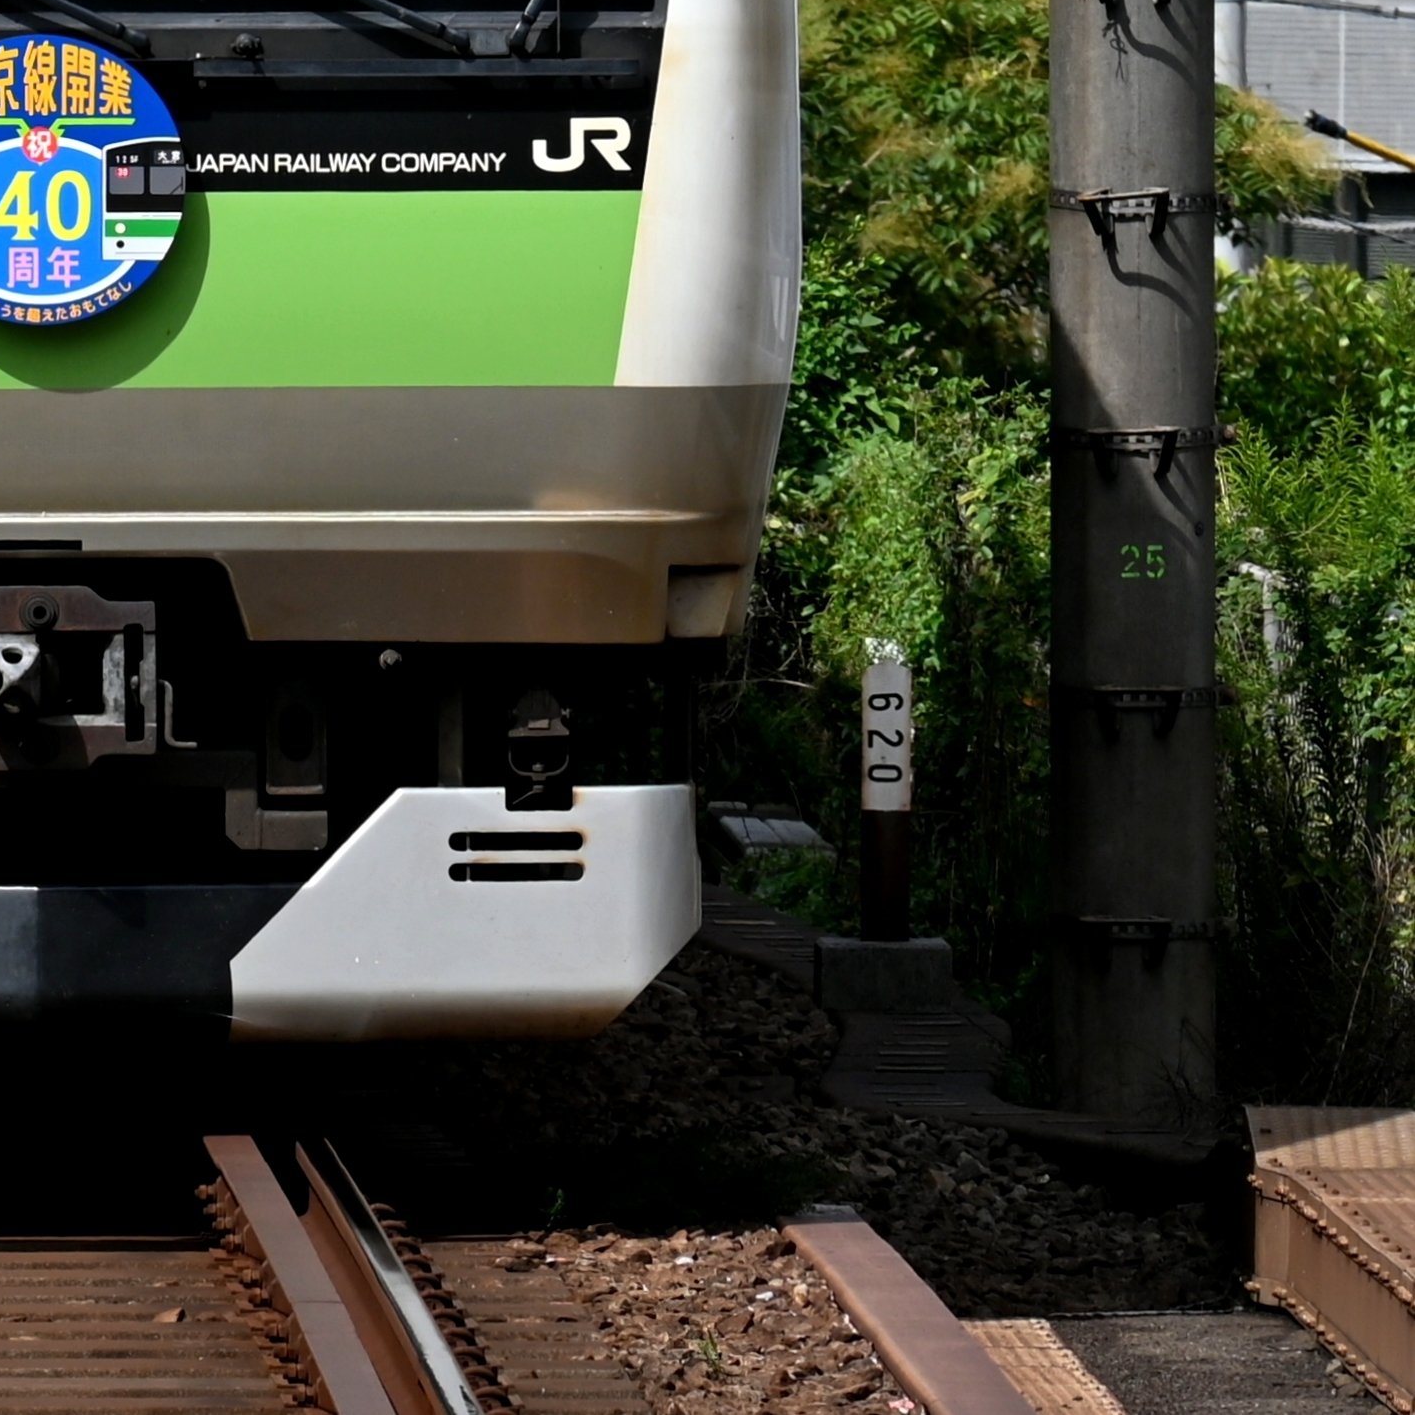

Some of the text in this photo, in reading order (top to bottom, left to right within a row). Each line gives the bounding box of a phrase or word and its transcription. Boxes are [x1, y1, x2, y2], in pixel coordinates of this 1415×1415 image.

[26, 130, 53, 159] 祝
[185, 152, 507, 174] JAPAN RAILWAY COMPANY
[531, 116, 632, 173] JR
[6, 246, 82, 289] 周年
[1120, 543, 1167, 580] 25
[866, 691, 905, 784] 620
